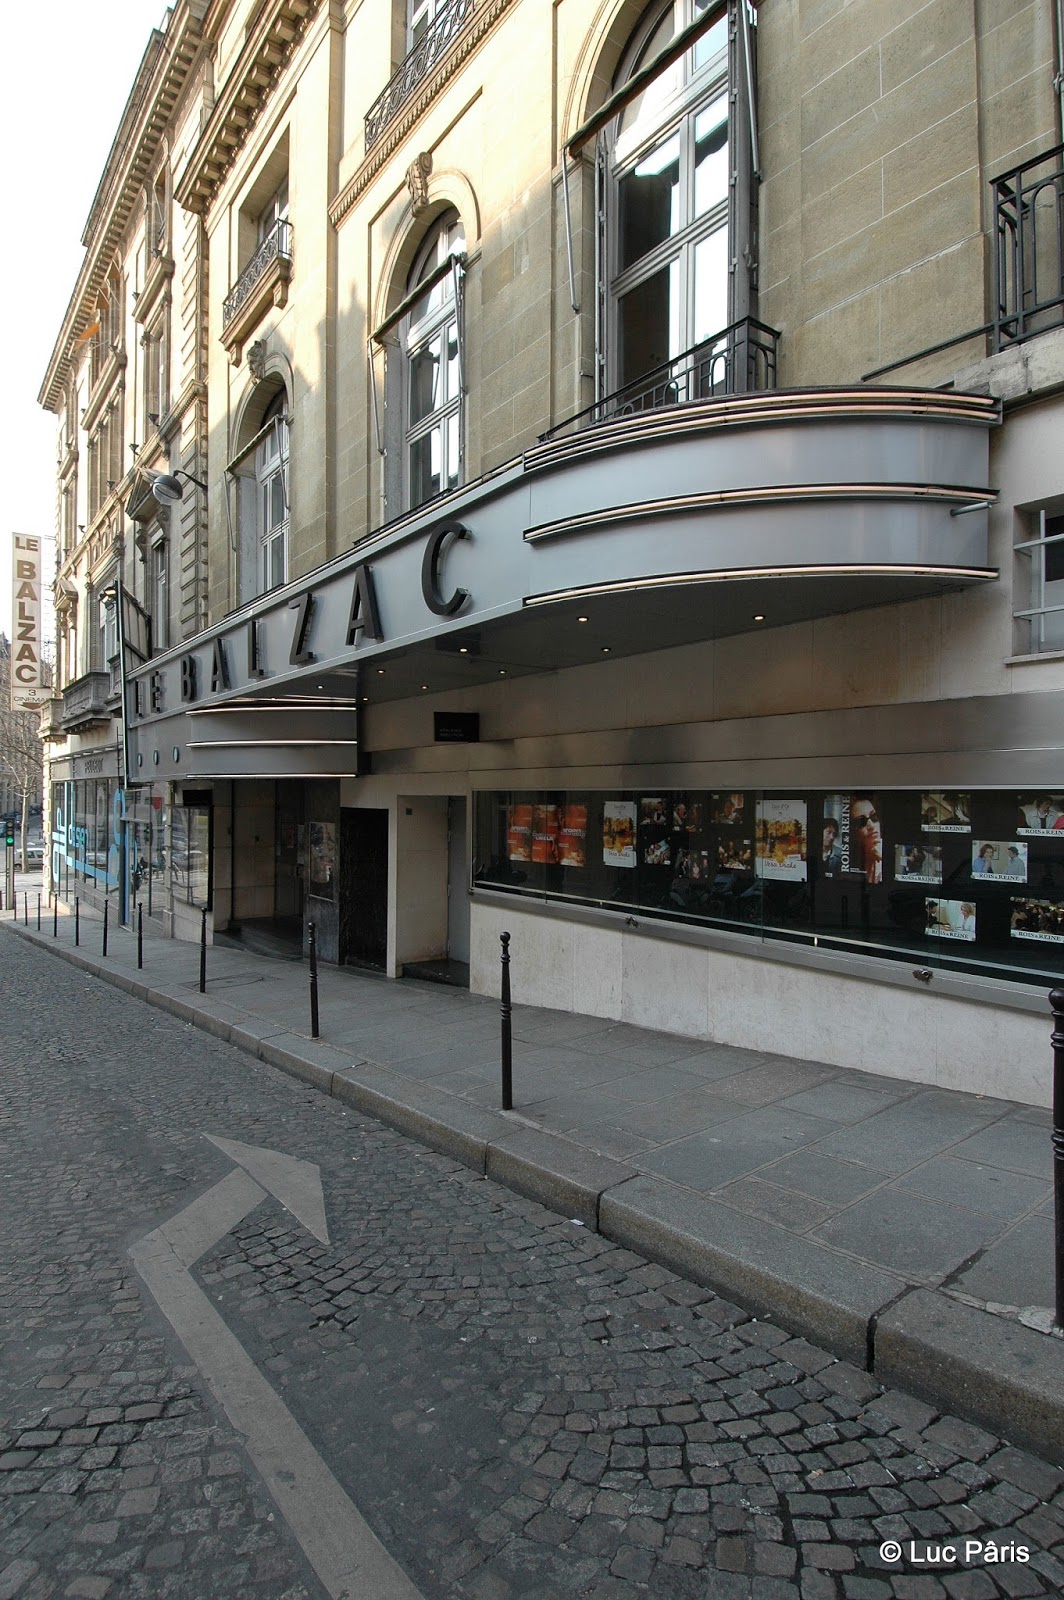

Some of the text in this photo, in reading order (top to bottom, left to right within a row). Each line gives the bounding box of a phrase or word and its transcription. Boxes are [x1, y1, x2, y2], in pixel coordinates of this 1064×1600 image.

[15, 535, 38, 552] LE
[15, 560, 38, 688] BALZAC
[134, 520, 472, 719] LE BALZAC
[842, 796, 850, 833] REINE
[840, 843, 850, 873] ROIS
